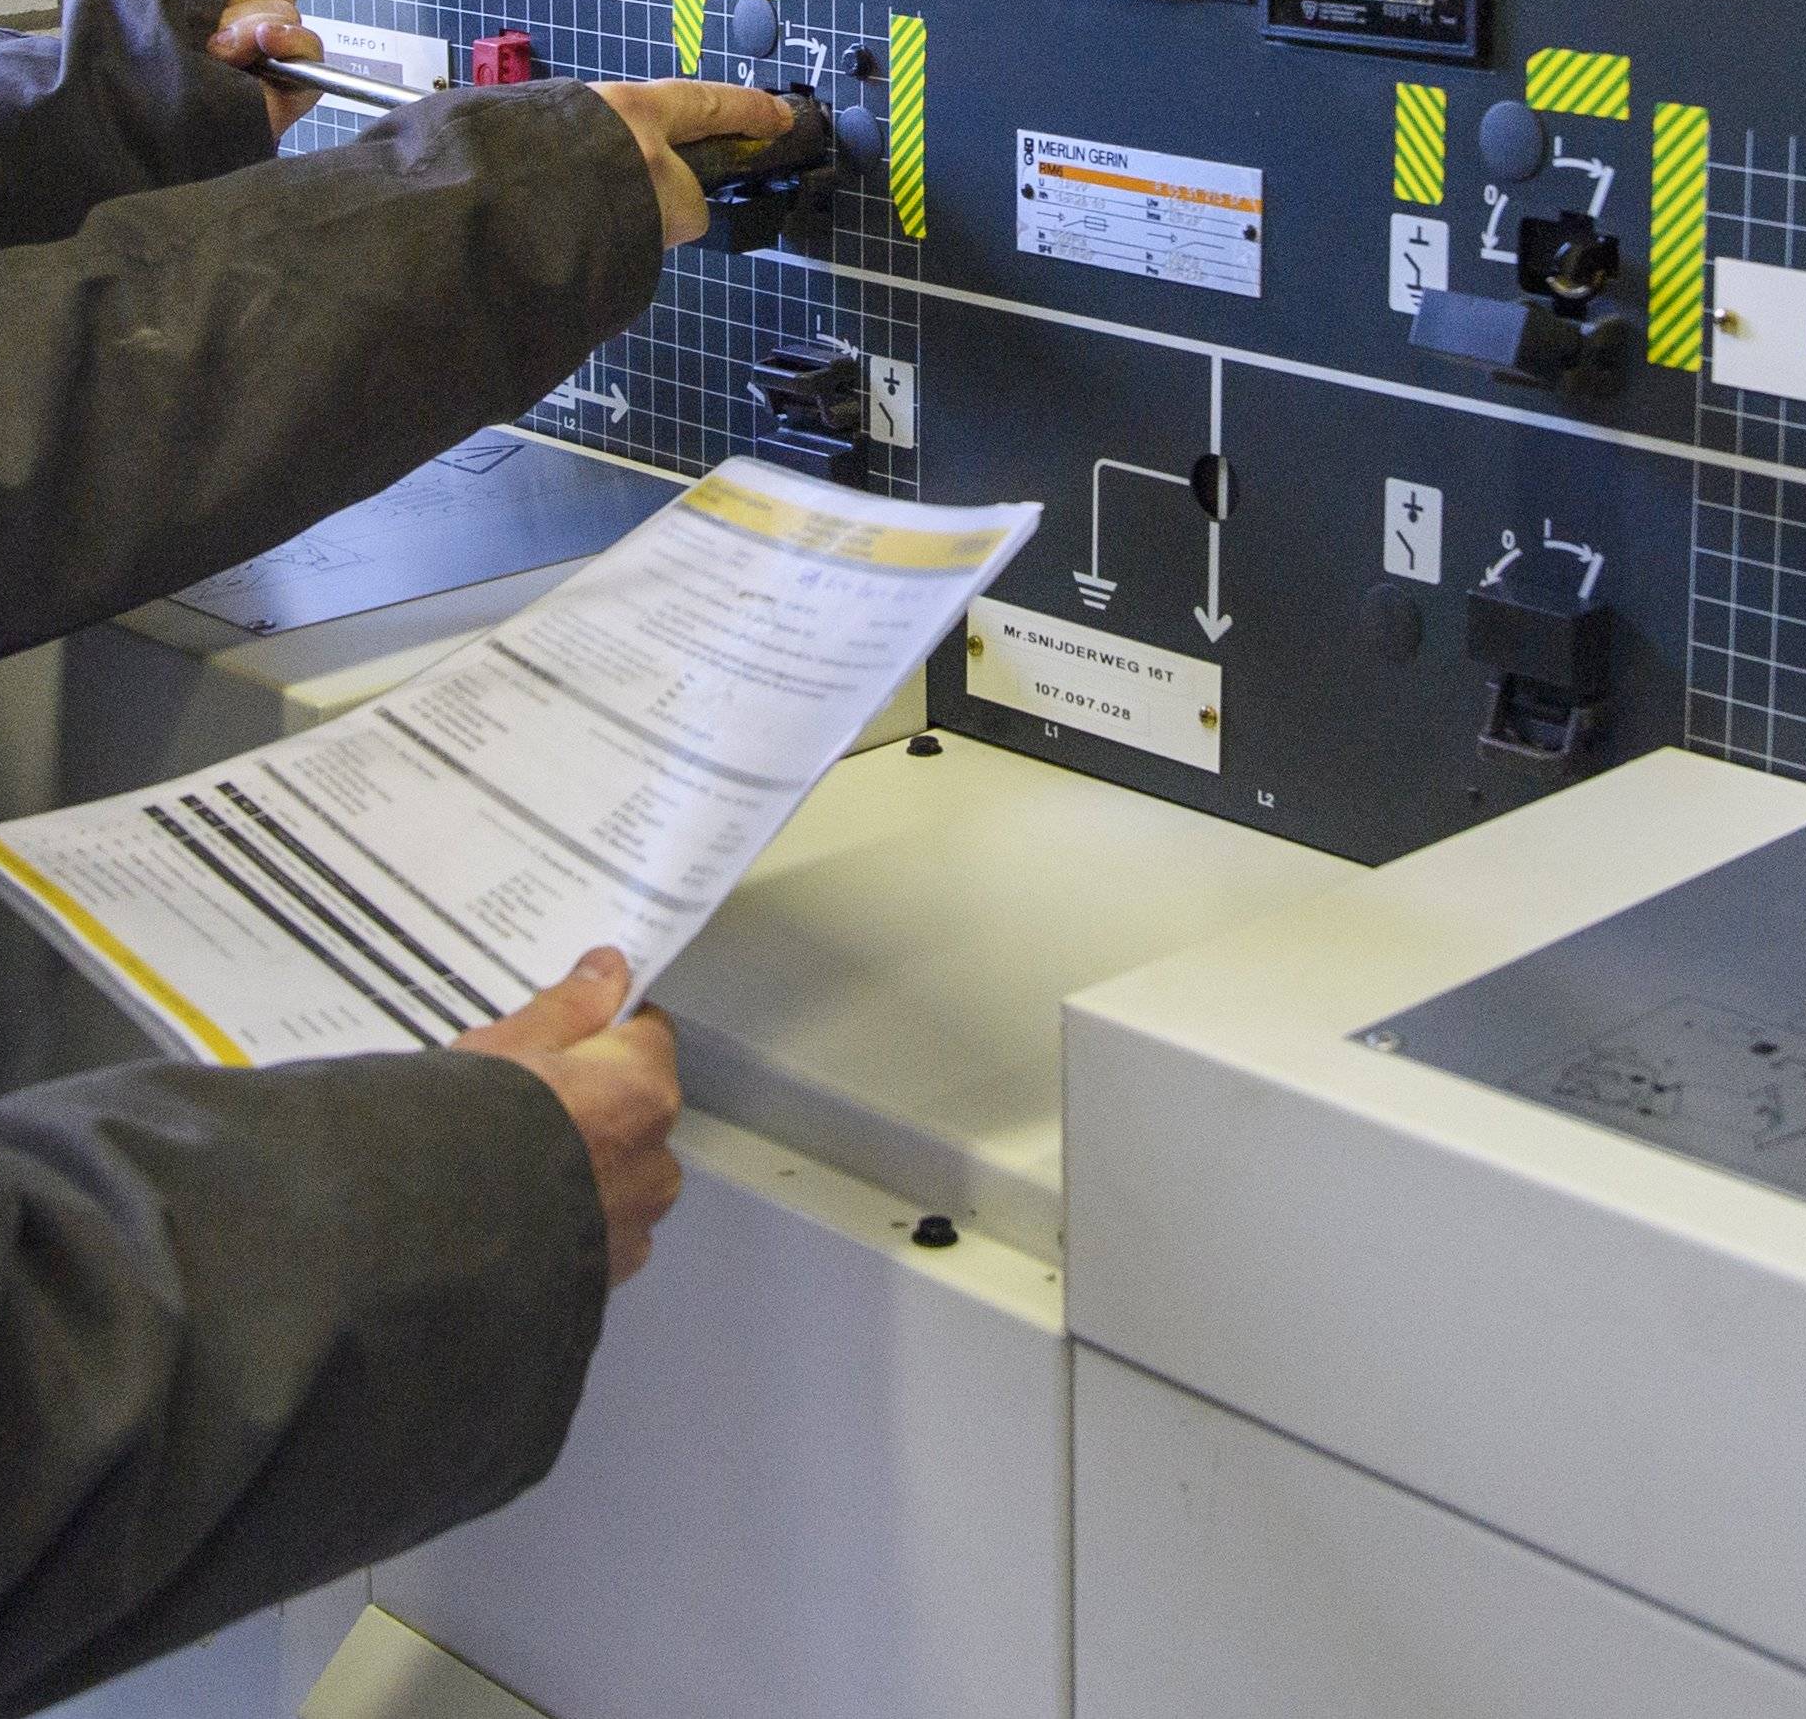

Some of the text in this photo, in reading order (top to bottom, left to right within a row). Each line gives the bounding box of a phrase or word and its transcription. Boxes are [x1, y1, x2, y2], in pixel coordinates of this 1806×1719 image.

[337, 33, 386, 52] TRAFO 1
[349, 62, 371, 76] 71A
[1038, 139, 1086, 161] MERLIN
[1089, 148, 1128, 169] GERIN
[1038, 162, 1064, 178] RM6
[1002, 623, 1174, 684] Mr.SNIJDERWEG 16T
[1034, 681, 1132, 721] 107.097.028
[1045, 722, 1059, 740] L1
[1257, 789, 1275, 809] L2
